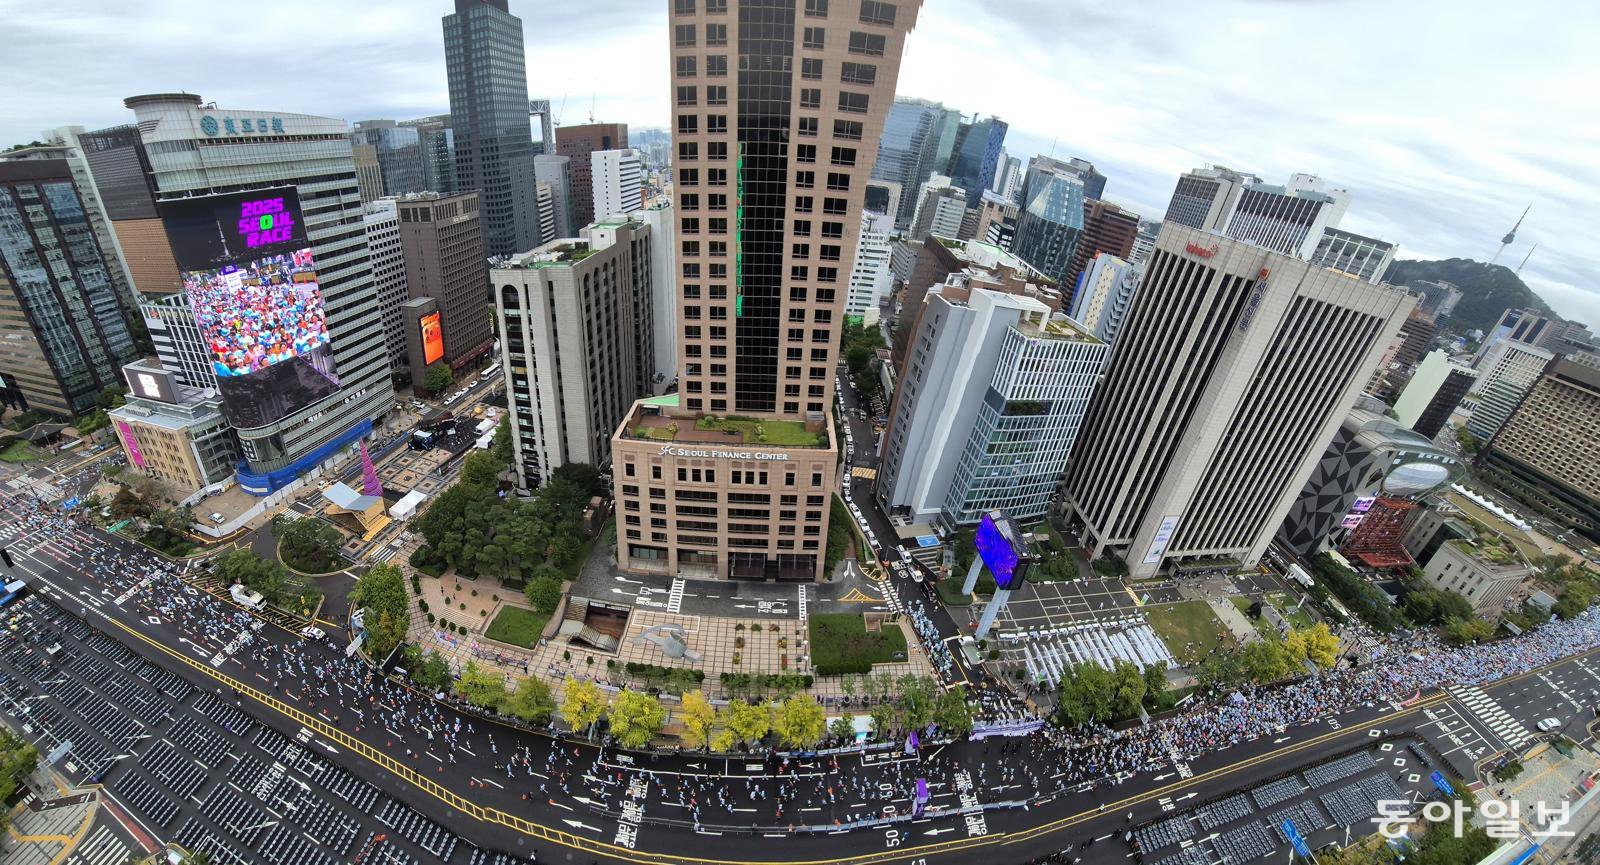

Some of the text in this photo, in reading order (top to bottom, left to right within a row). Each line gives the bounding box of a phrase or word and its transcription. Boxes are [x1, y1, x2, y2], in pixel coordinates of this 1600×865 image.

[241, 197, 284, 218] 2025
[238, 211, 294, 234] SEOUL
[247, 225, 292, 248] RACE
[613, 823, 638, 849] 광화문
[965, 814, 988, 838] 광화문
[886, 829, 900, 848] 50
